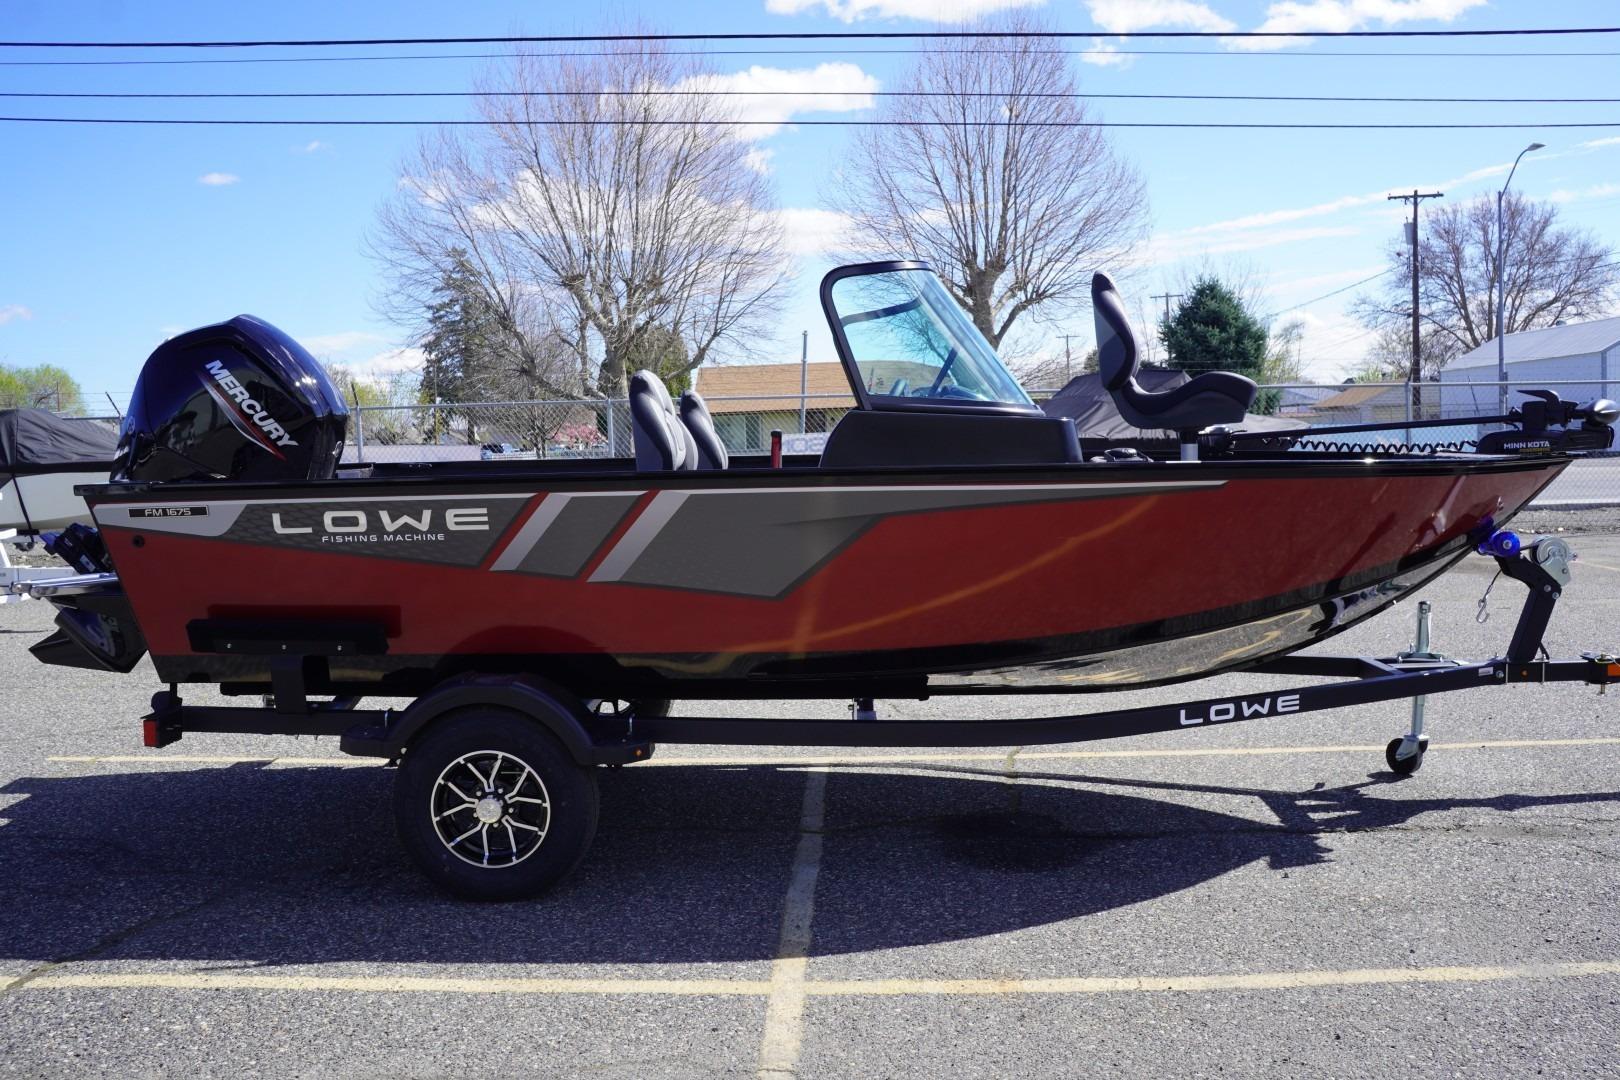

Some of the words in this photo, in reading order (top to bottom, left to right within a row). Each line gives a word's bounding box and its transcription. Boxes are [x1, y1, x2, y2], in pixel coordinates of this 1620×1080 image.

[205, 360, 299, 447] MERCURY
[1527, 440, 1550, 448] KOTA
[144, 508, 163, 517] FM
[166, 508, 192, 516] 1675
[271, 508, 490, 535] LOWE
[322, 535, 378, 543] FISHING
[383, 533, 446, 541] MACHINE
[1179, 694, 1300, 726] LOWE
